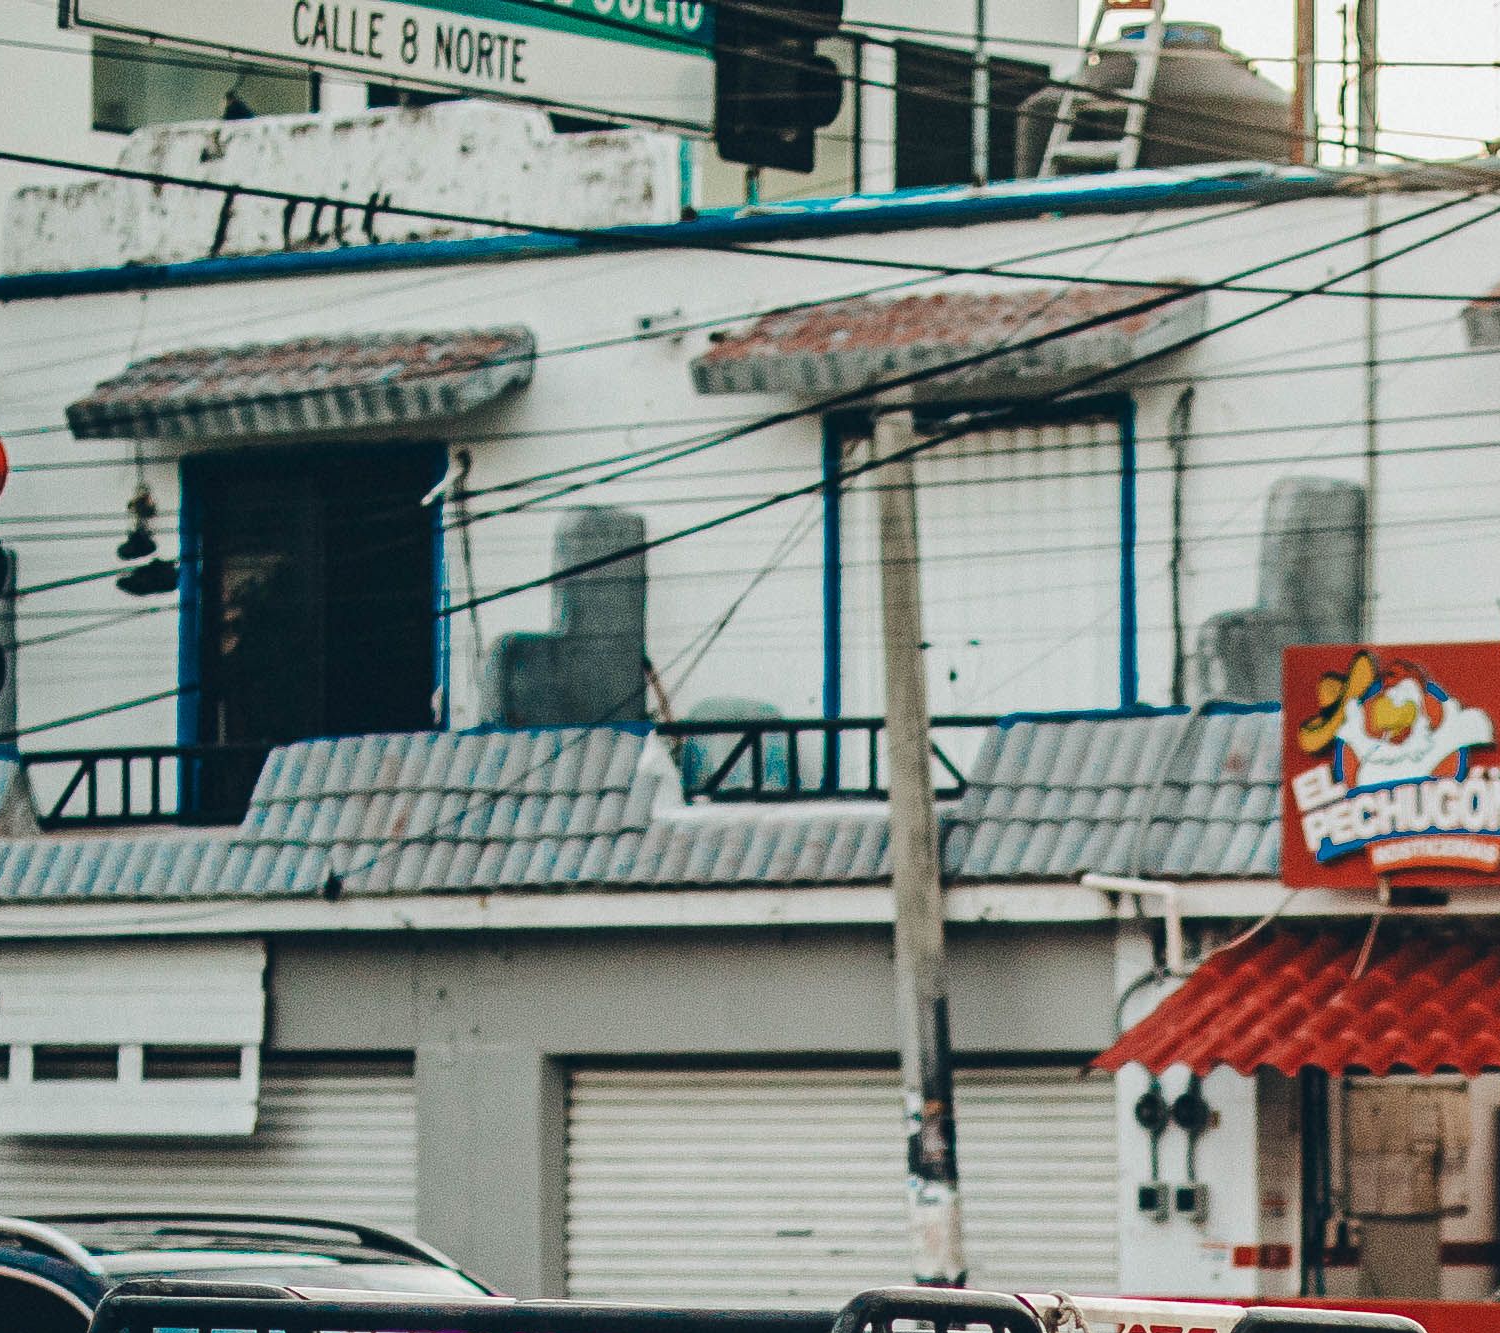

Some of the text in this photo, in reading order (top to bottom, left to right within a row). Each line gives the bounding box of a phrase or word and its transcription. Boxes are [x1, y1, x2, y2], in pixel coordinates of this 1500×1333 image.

[291, 3, 528, 84] CALLE 8 NORTE
[1292, 764, 1350, 813] EL
